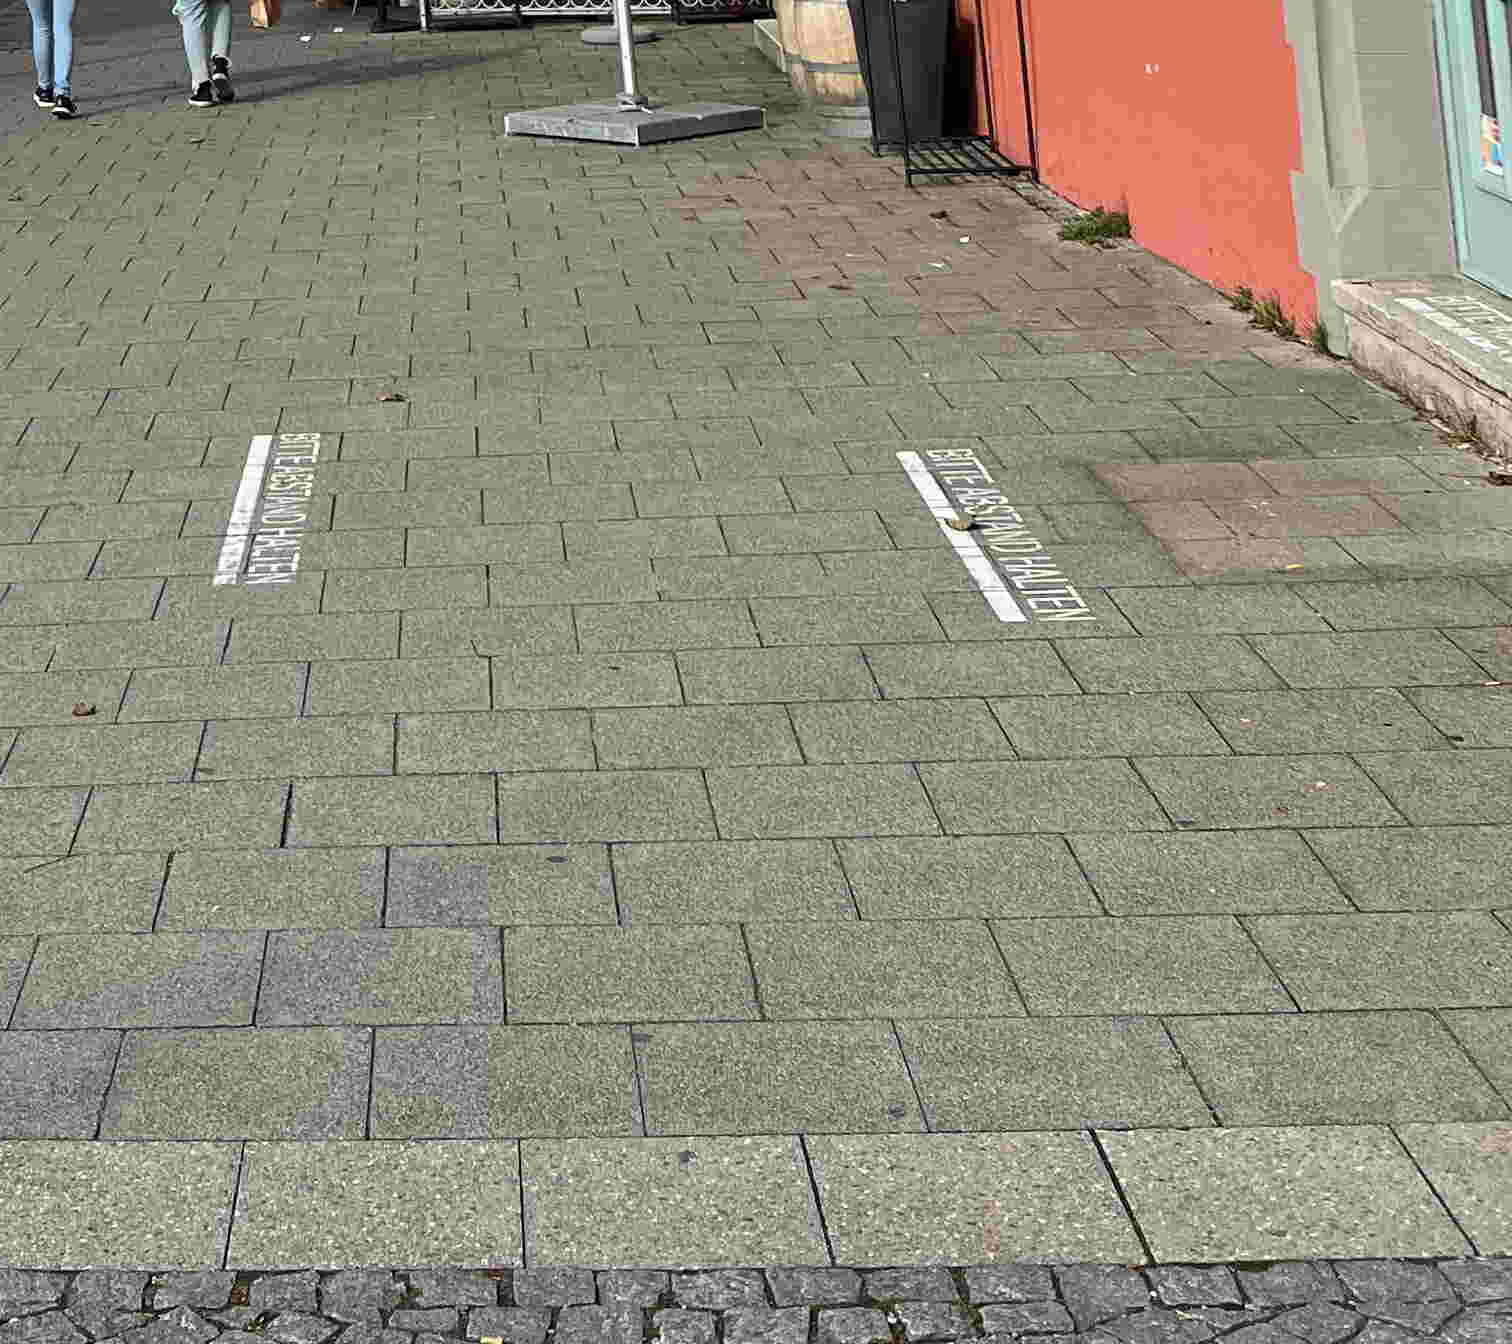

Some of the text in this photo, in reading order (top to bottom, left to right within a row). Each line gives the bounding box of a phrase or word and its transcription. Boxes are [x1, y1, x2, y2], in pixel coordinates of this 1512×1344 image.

[245, 432, 321, 585] BITTE ABSTAND HALTEN
[925, 448, 1097, 621] BITTE ABSTAND HALTEN
